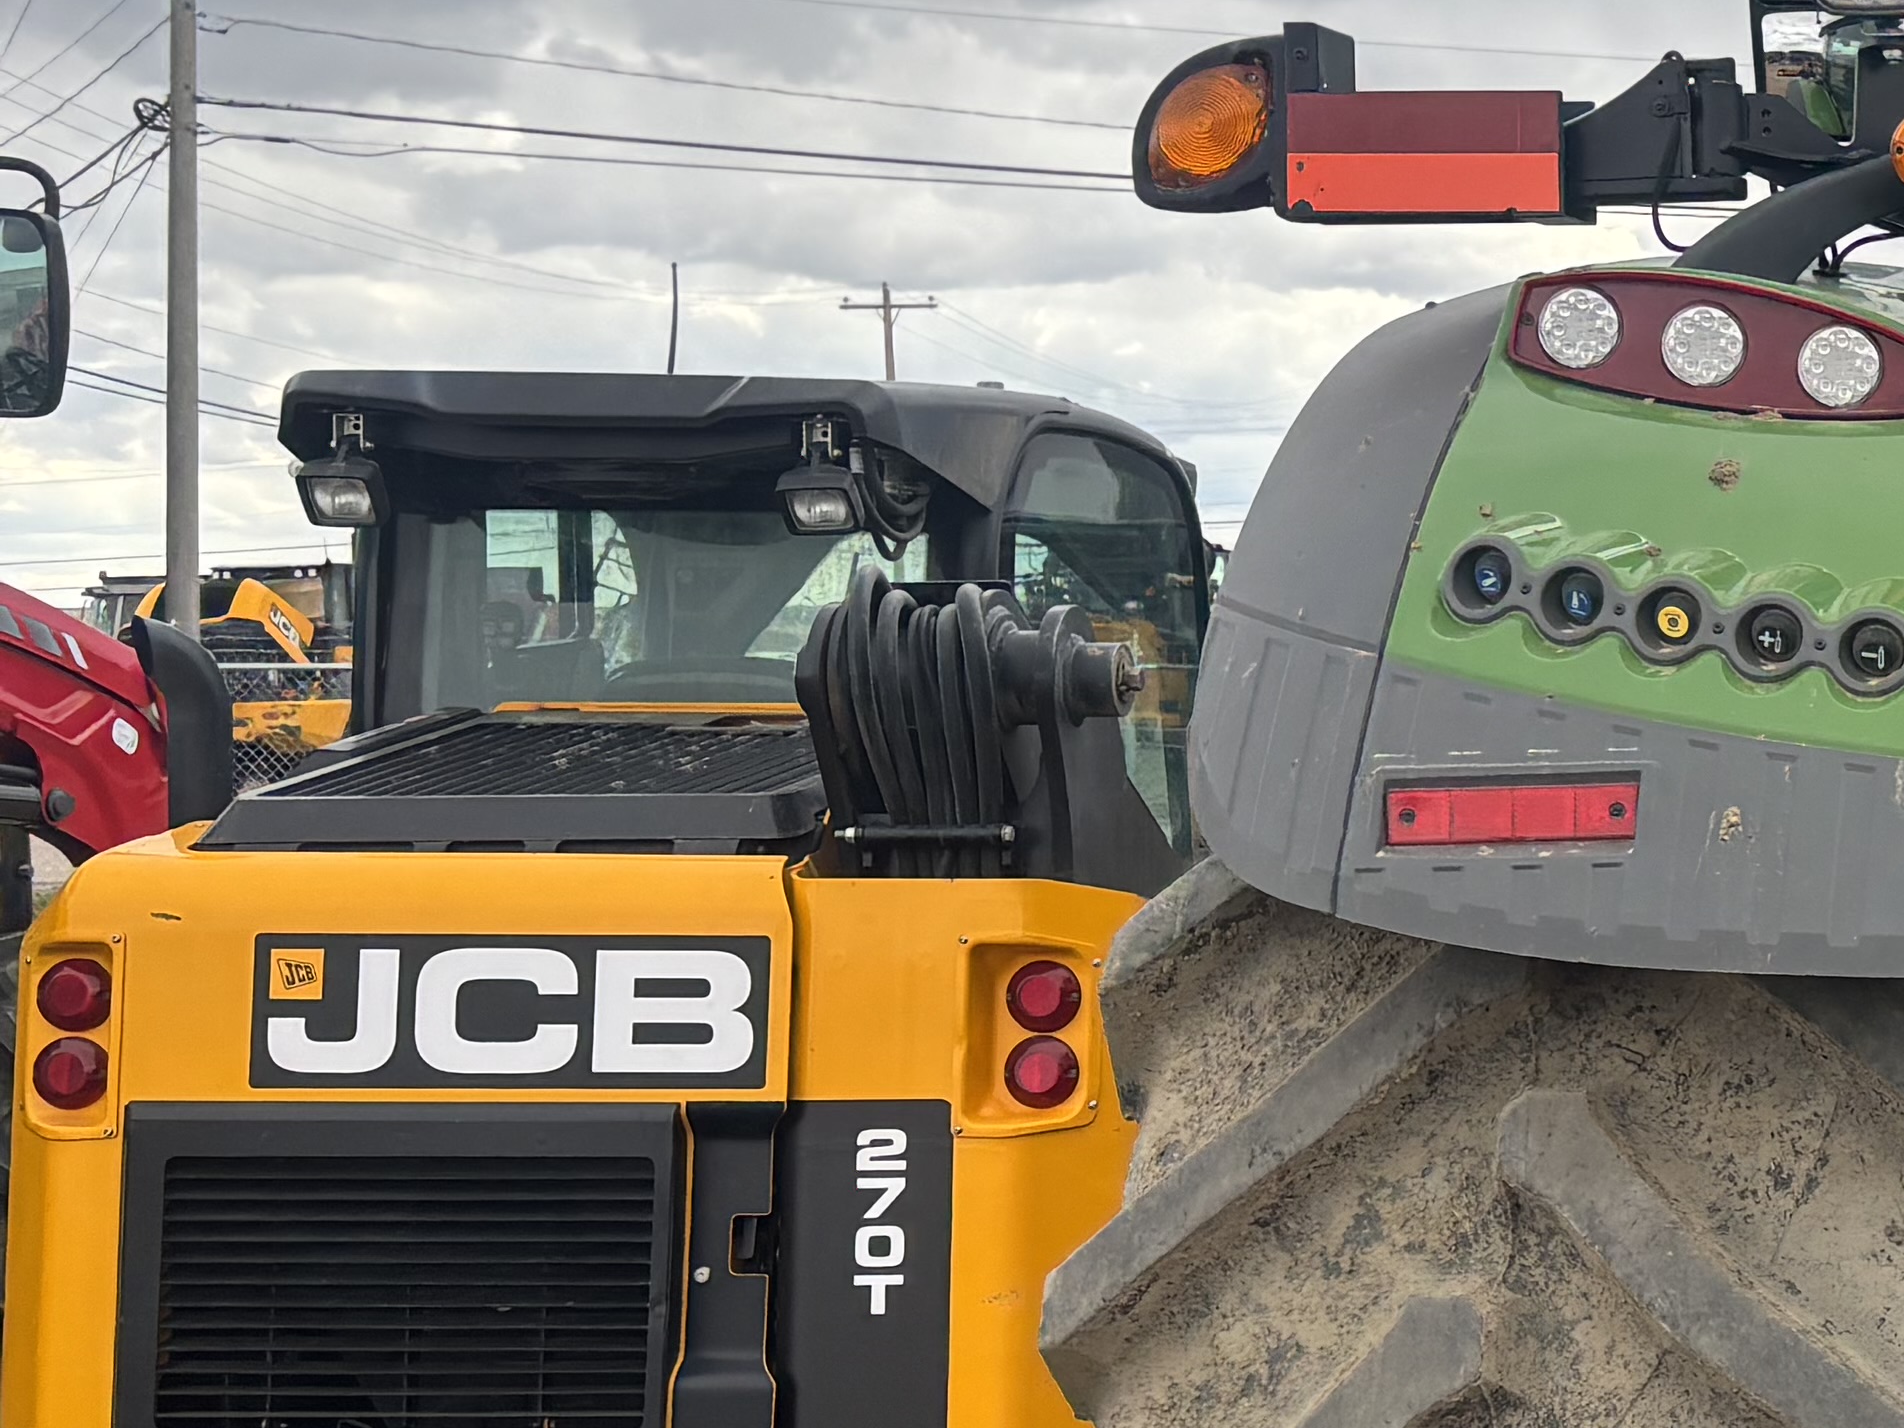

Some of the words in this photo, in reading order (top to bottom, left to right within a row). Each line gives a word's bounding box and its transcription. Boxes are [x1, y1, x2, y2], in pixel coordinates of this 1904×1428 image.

[270, 606, 300, 647] JCB
[267, 947, 754, 1074] JCB
[284, 962, 315, 986] JCB
[853, 1128, 908, 1315] 270T
